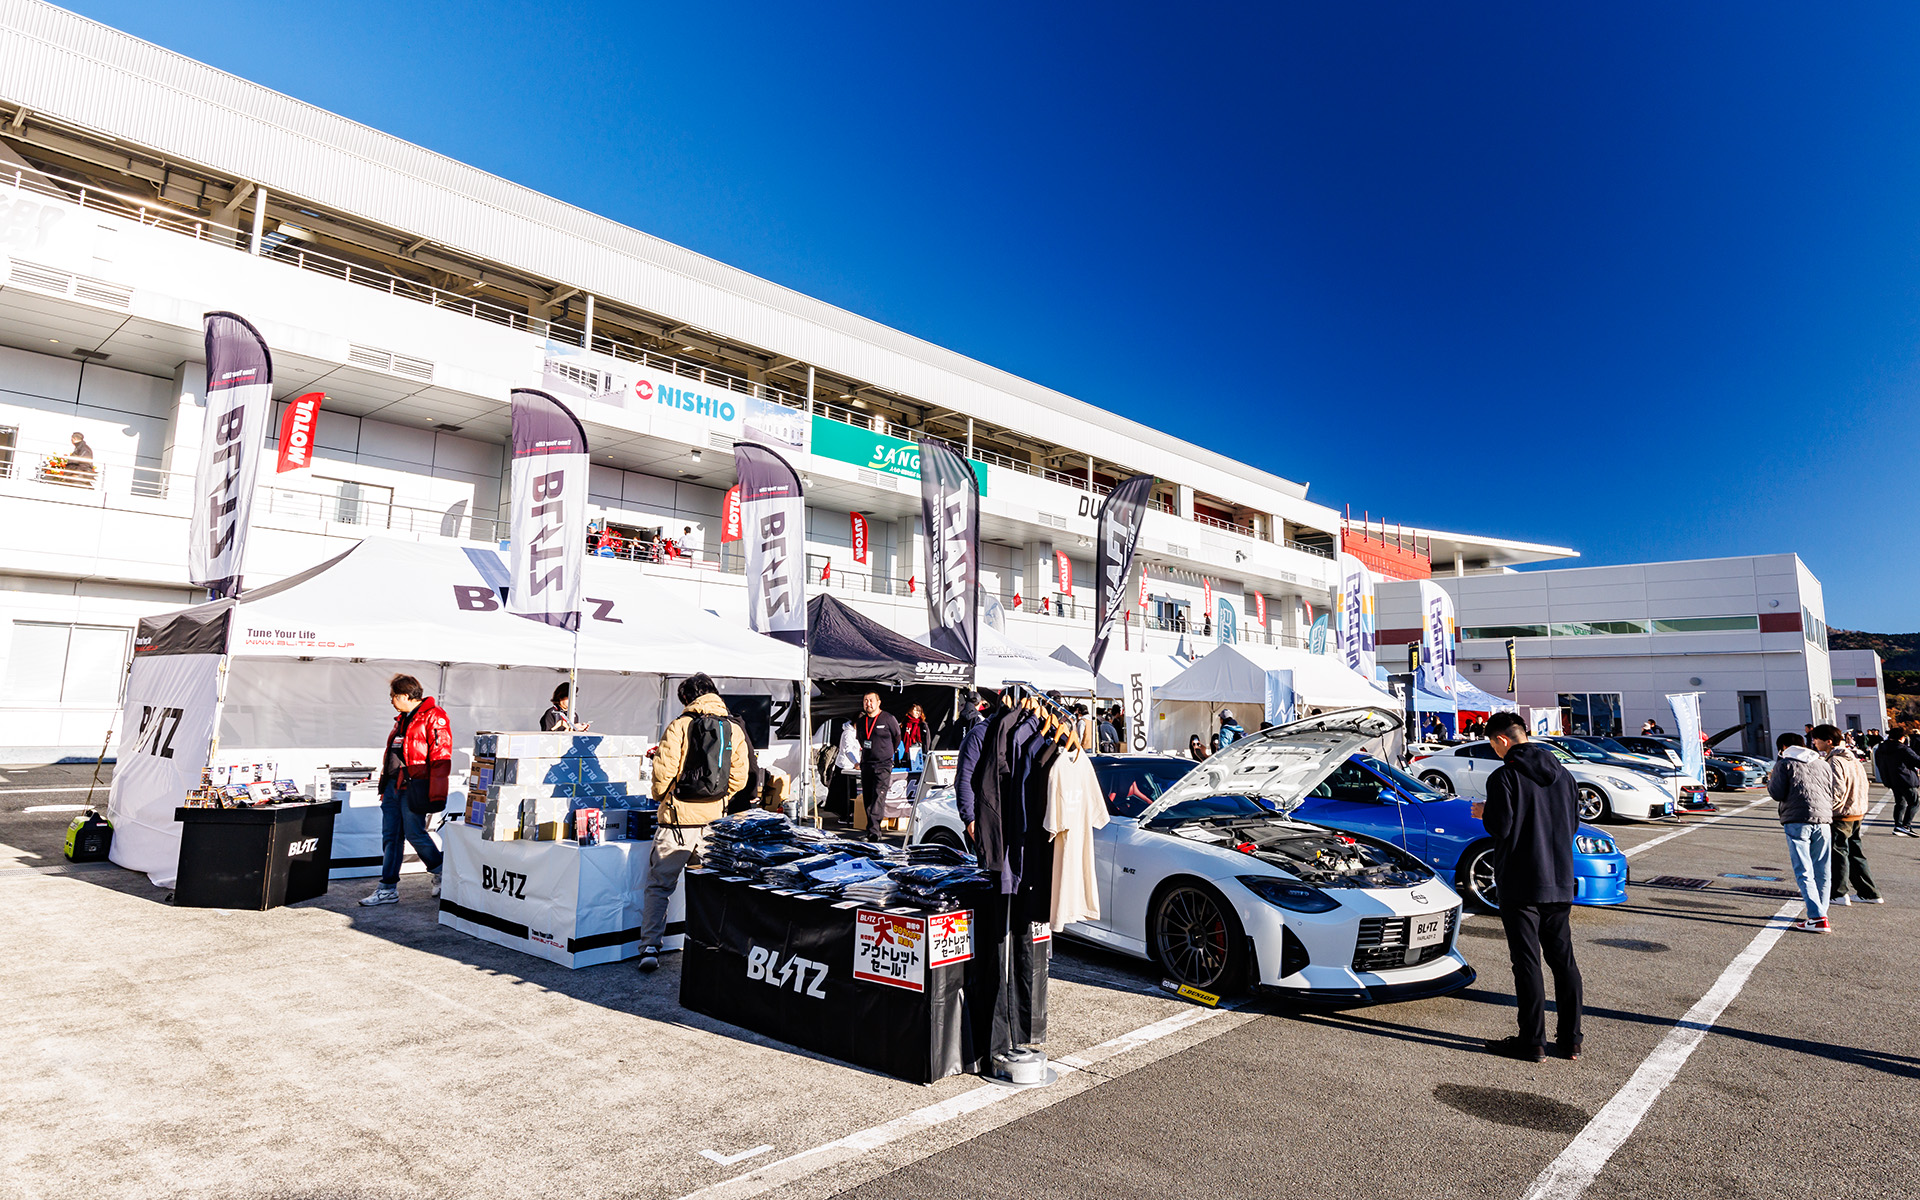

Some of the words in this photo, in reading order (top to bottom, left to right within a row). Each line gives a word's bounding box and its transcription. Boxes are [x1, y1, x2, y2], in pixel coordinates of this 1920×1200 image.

[657, 383, 735, 422] NISHIO
[287, 400, 315, 466] MOTUL
[873, 445, 920, 470] SANG
[247, 628, 272, 638] Tune
[274, 629, 297, 639] Your
[299, 630, 316, 640] Life
[915, 662, 969, 675] SHAFT
[287, 837, 319, 857] BLITZ
[1122, 867, 1136, 875] BLITZ
[481, 864, 528, 900] BLITZ
[860, 914, 876, 923] BLITZ
[941, 917, 956, 940] 大
[1417, 921, 1438, 934] BLITZ
[873, 916, 895, 947] 大
[892, 924, 921, 941] 50%OFF
[934, 934, 971, 950] アウトレット
[860, 942, 919, 966] アウトレット
[747, 945, 829, 999] BLITZ
[1186, 989, 1215, 1002] DUNLOP
